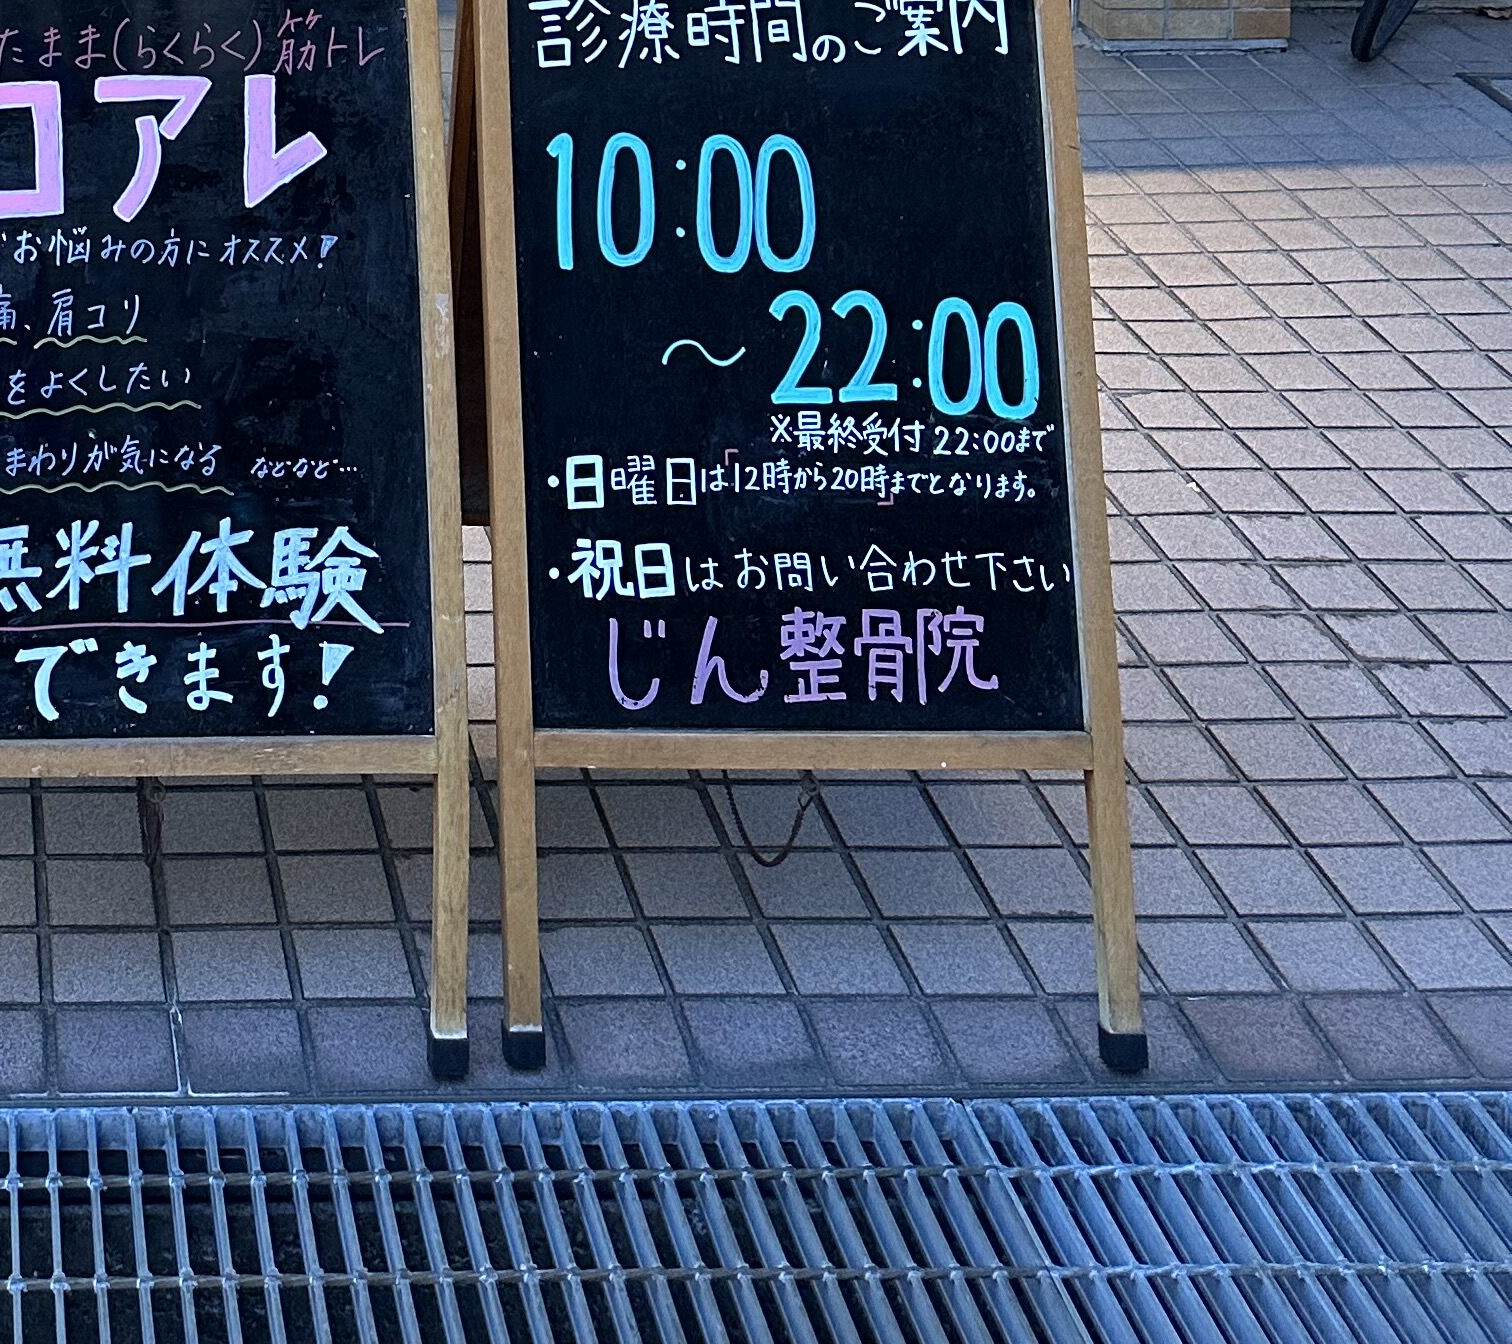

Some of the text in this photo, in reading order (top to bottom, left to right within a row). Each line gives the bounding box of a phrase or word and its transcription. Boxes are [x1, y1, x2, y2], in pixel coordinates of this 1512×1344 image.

[546, 132, 817, 274] 10:00
[14, 633, 355, 722] できます!
[608, 605, 1000, 711] じん整骨院
